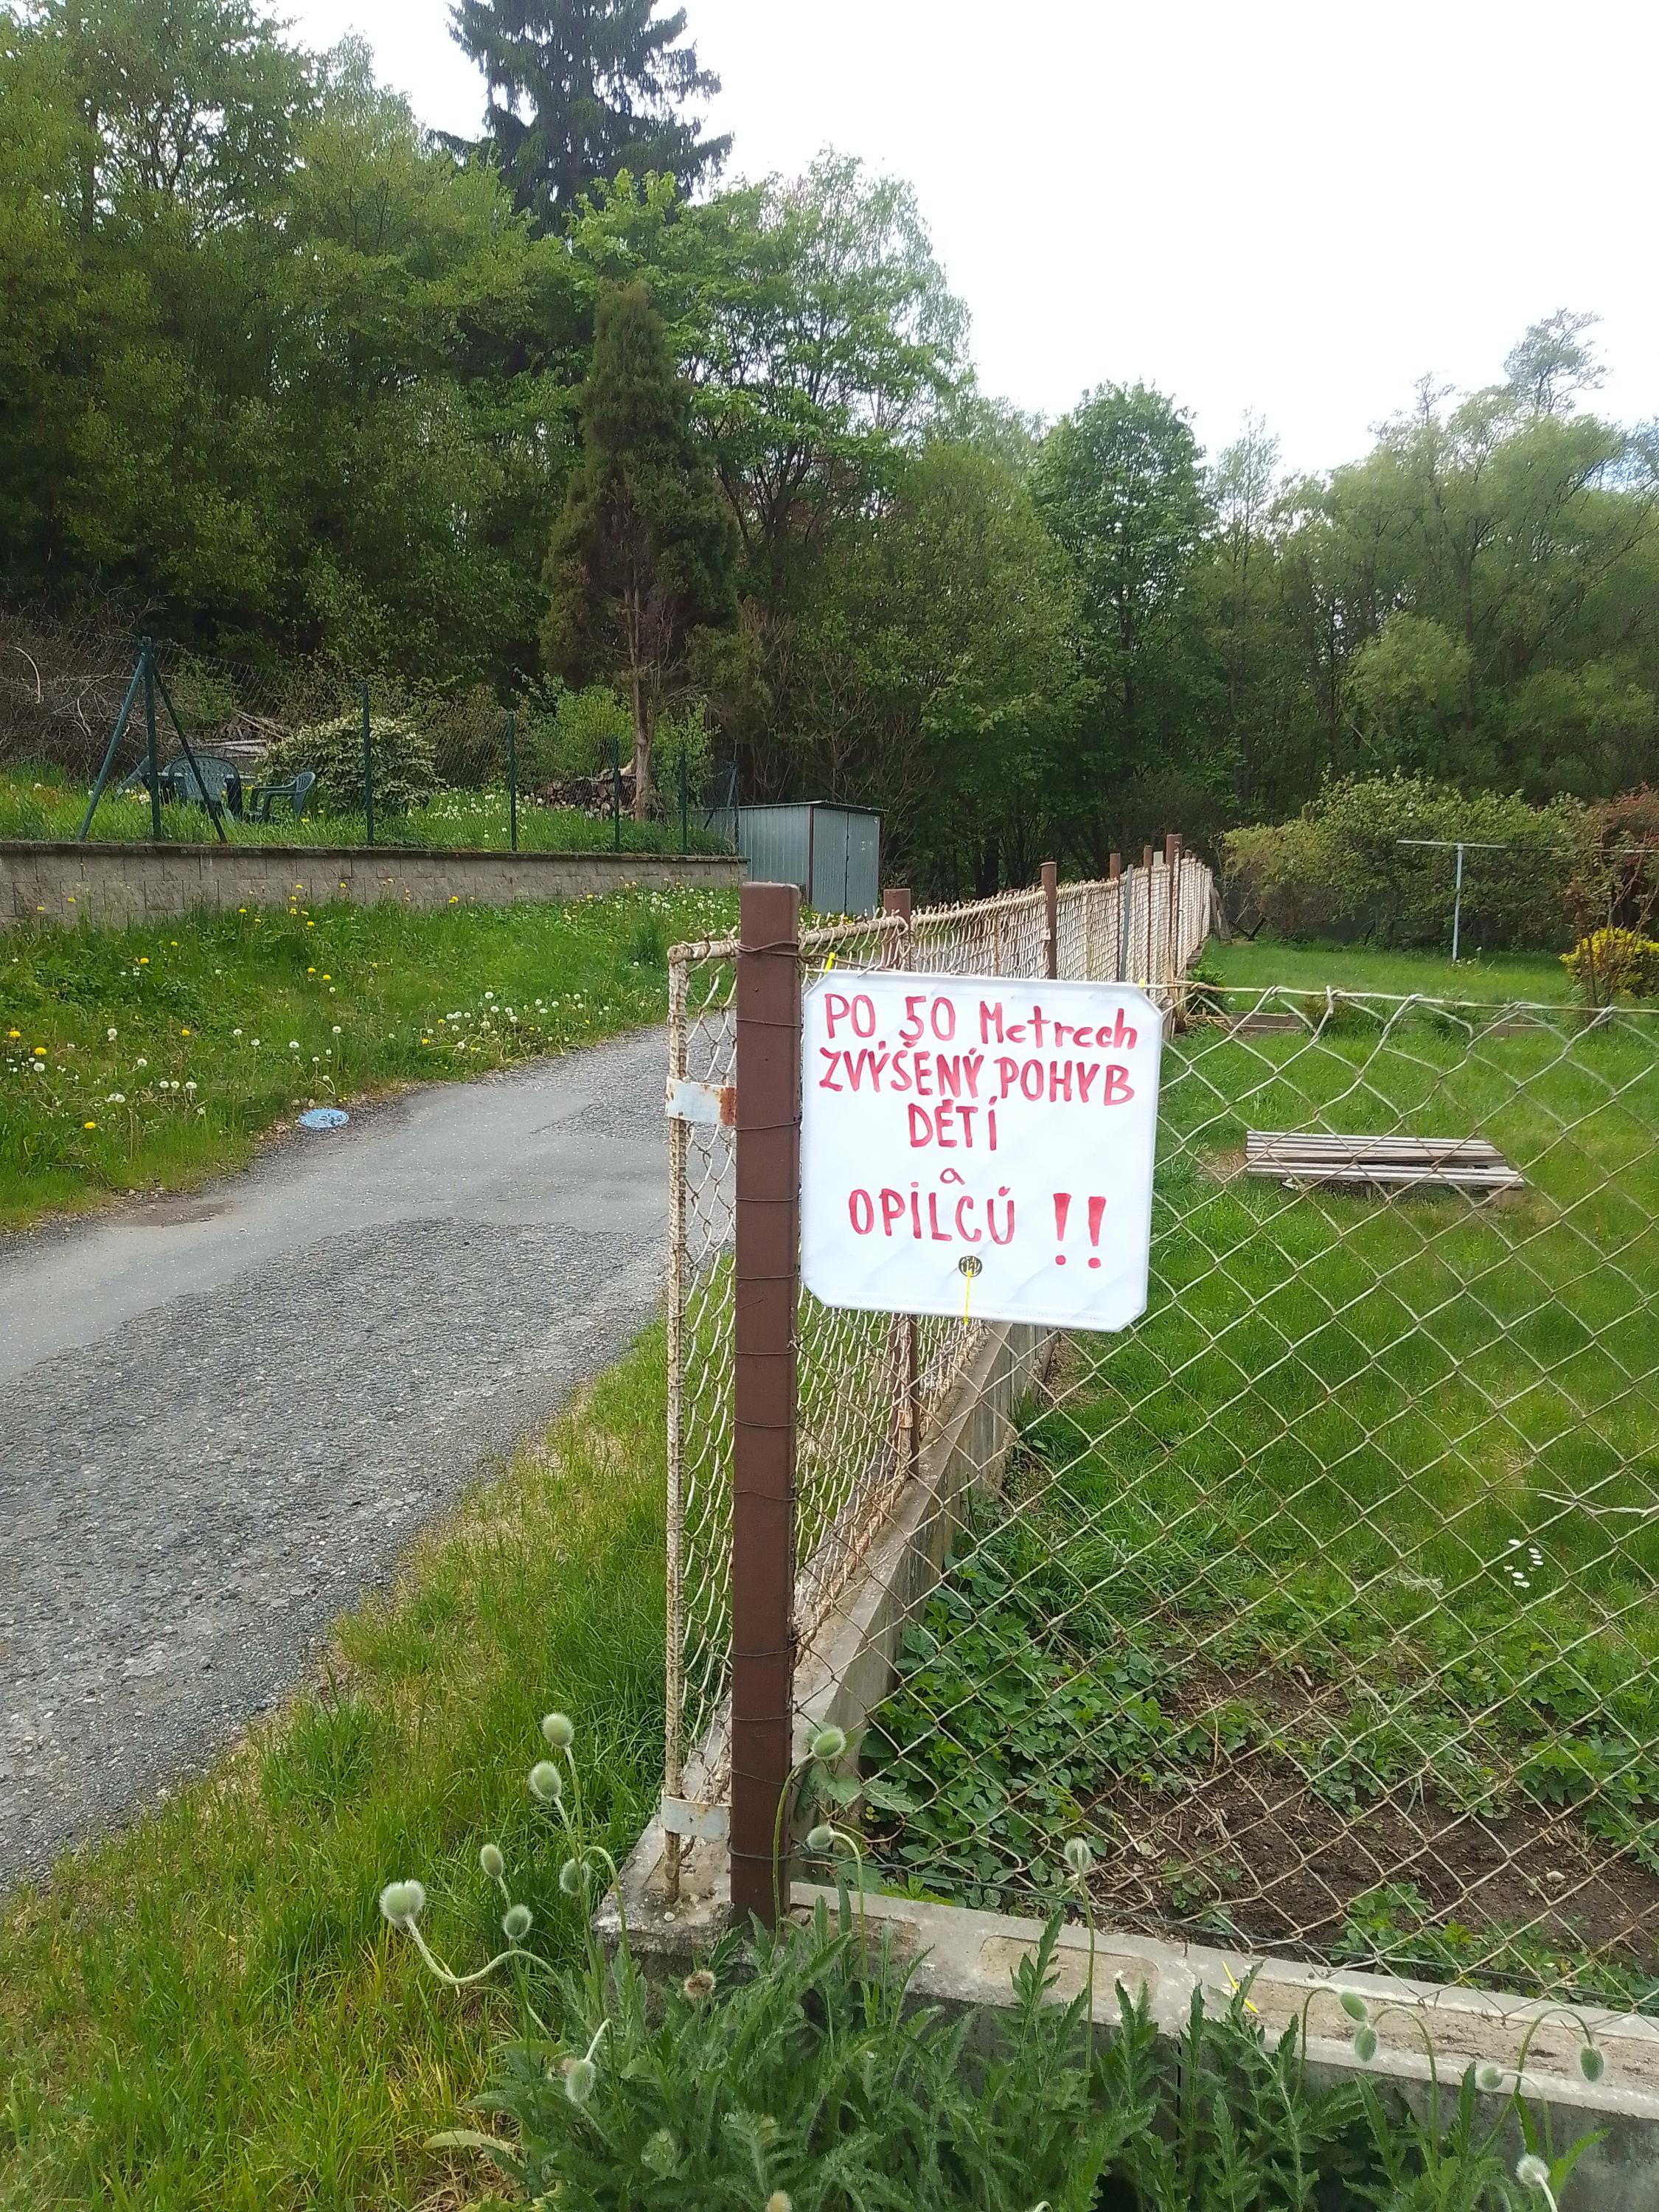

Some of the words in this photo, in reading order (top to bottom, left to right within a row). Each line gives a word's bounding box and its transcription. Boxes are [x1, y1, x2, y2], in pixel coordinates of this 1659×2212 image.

[825, 993, 876, 1039] PO
[898, 996, 956, 1041] 50
[979, 1001, 1138, 1049] Metrech
[994, 1057, 1134, 1106] POHYB
[940, 1167, 965, 1185] a
